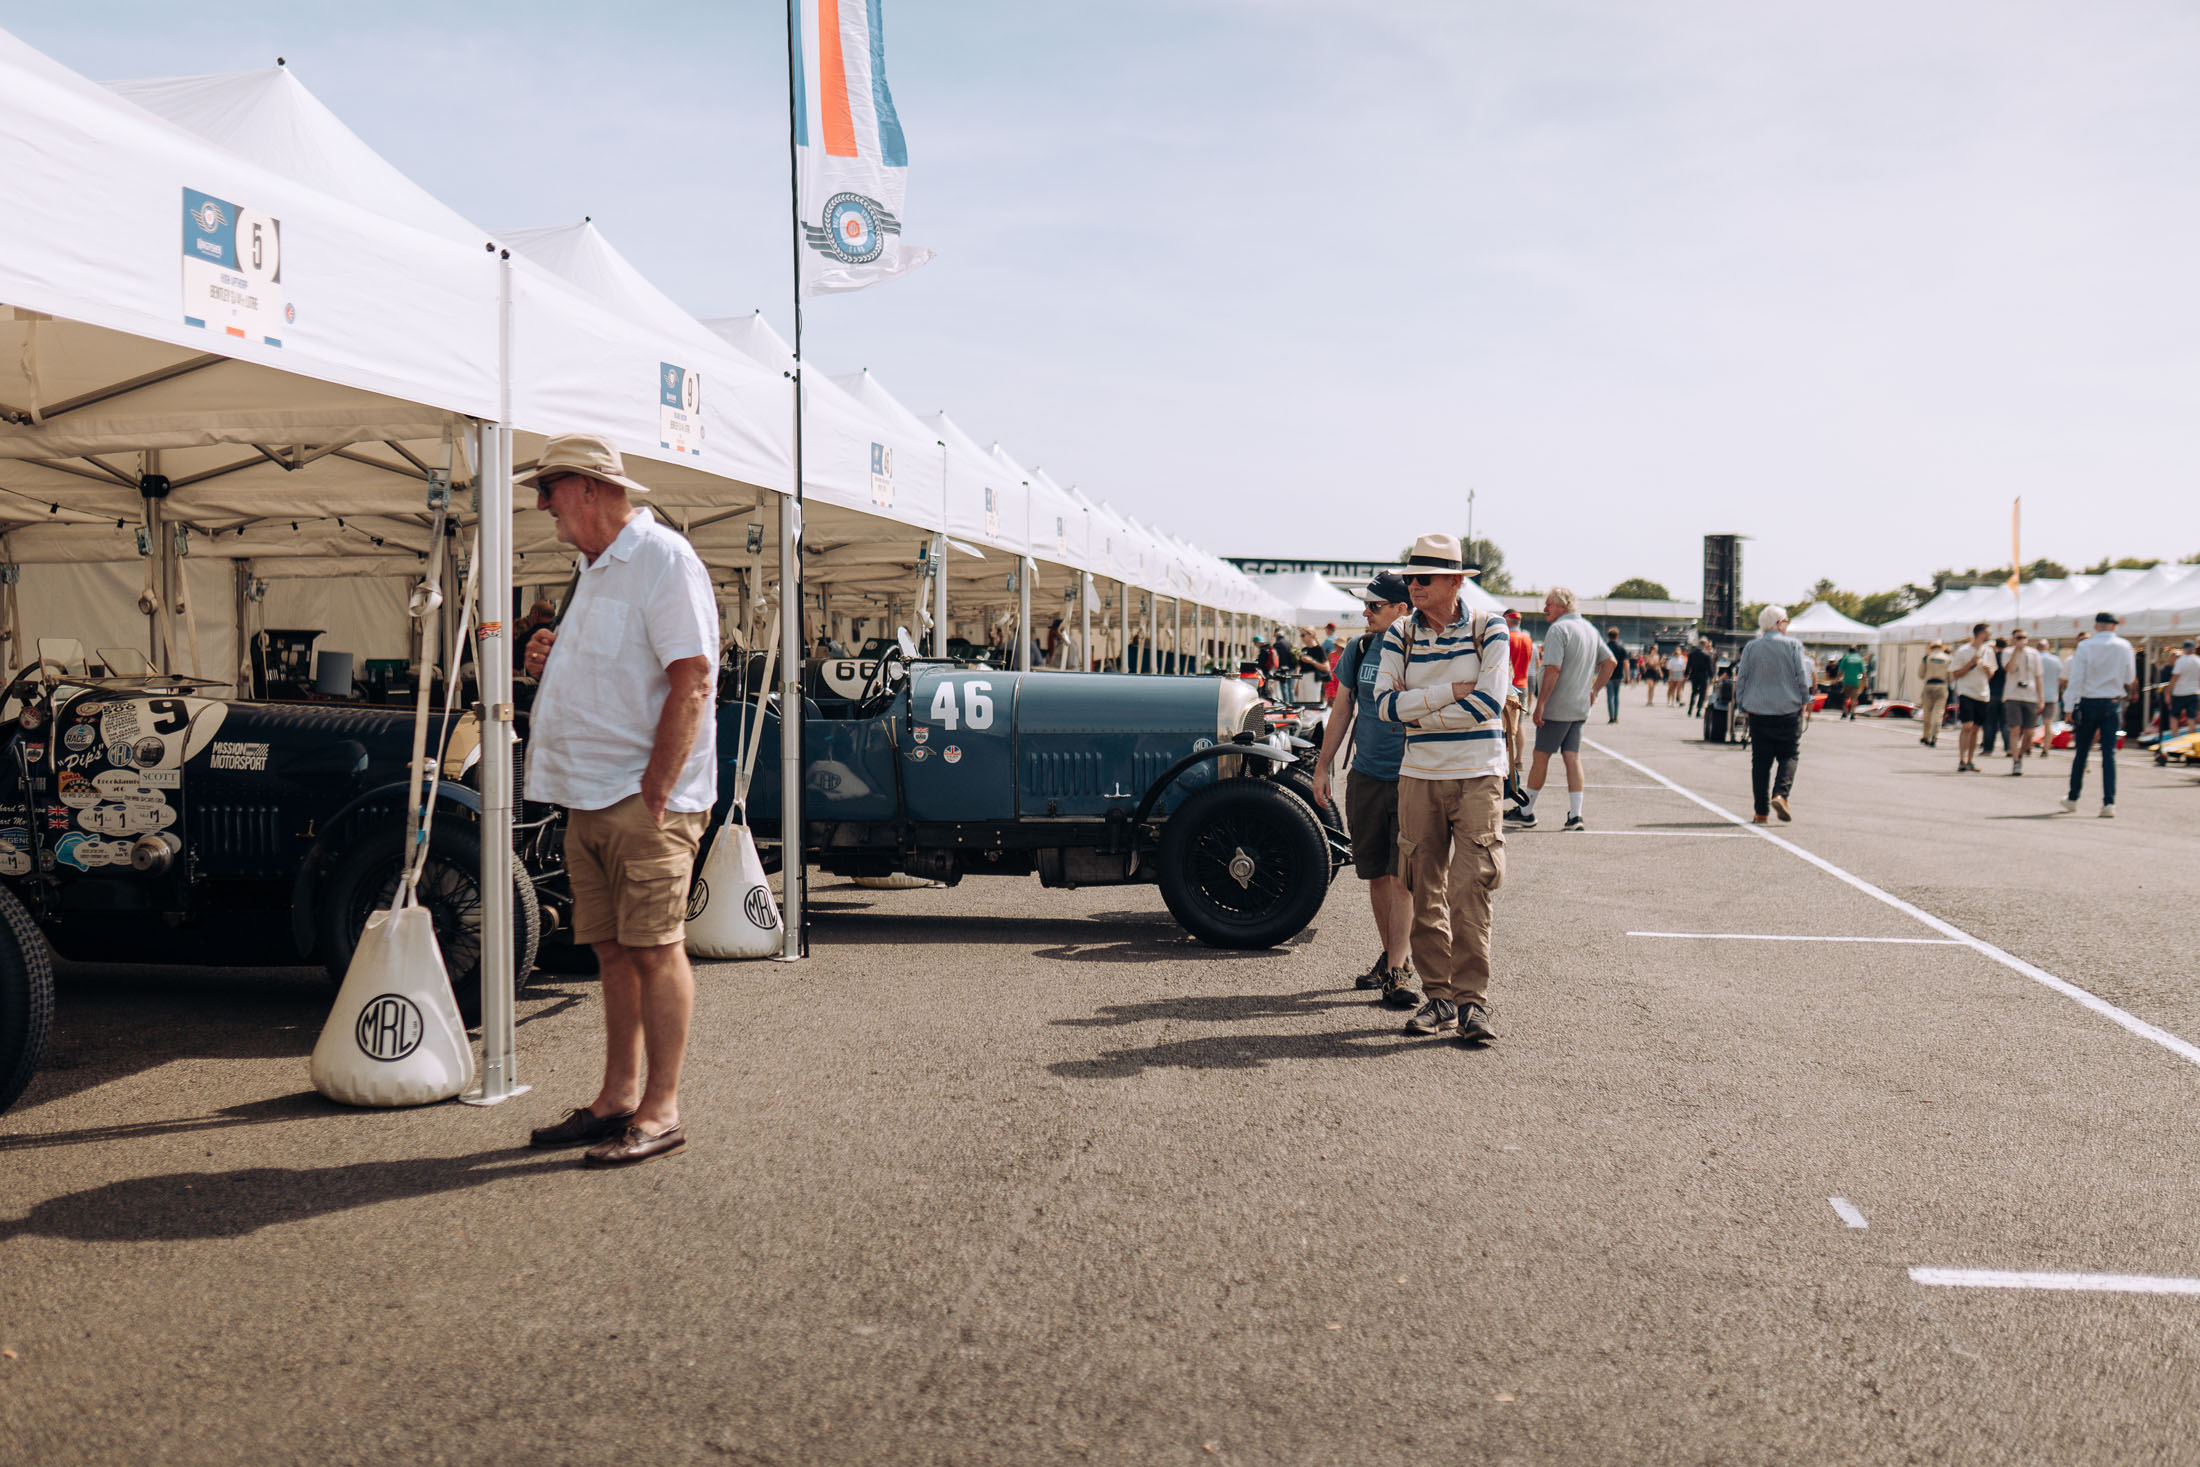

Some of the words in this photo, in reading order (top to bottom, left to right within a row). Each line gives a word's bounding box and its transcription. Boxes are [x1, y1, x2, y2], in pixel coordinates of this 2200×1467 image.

[252, 223, 262, 270] 5
[687, 377, 693, 408] 9
[835, 661, 879, 681] 66
[1360, 666, 1380, 681] LUF
[149, 700, 190, 735] 9
[931, 681, 994, 731] 46
[210, 755, 268, 771] MOTORSPORT
[213, 742, 247, 756] MISSION
[142, 772, 177, 781] SCOTT
[748, 888, 776, 927] MRL
[360, 999, 413, 1057] MRL
